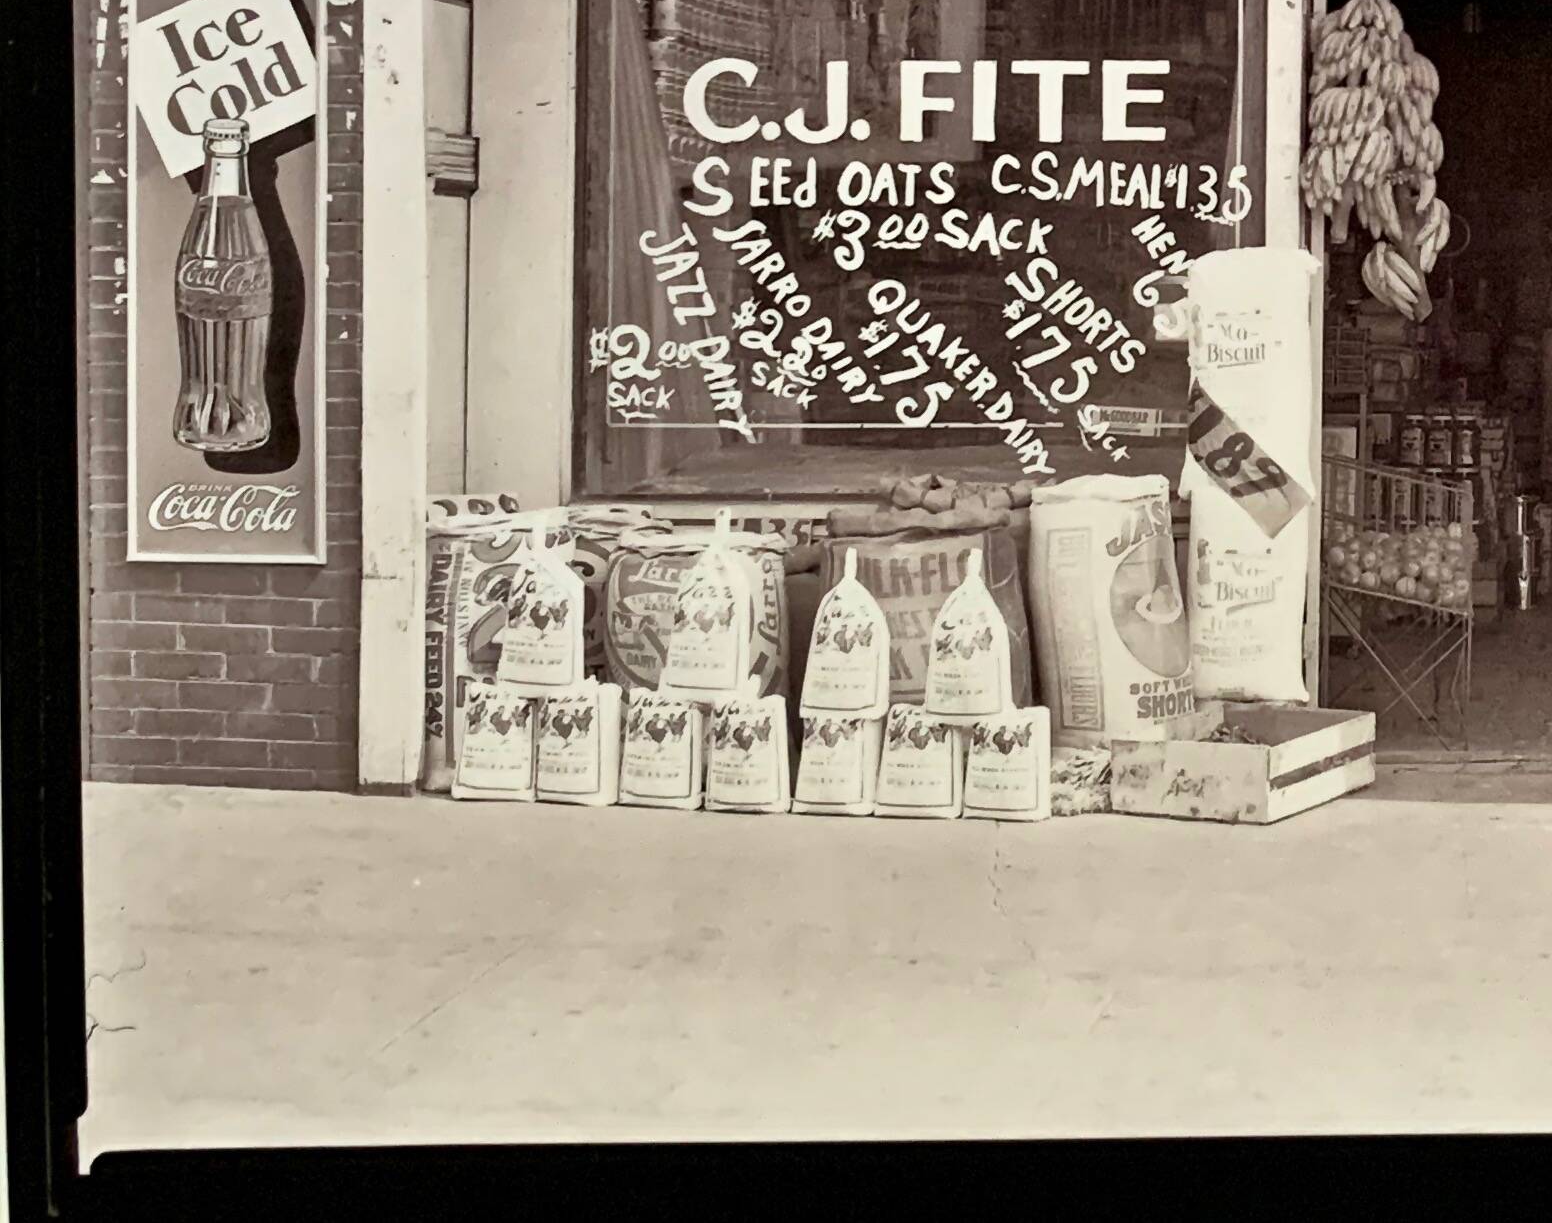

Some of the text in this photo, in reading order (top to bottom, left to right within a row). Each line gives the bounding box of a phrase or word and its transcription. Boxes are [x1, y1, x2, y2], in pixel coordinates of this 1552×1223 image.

[156, 7, 264, 79] Ice
[167, 40, 308, 137] Cold
[899, 59, 1170, 143] FITE
[837, 161, 956, 207] OATS
[934, 208, 1054, 256] SACK
[1131, 214, 1194, 275] HEN
[639, 222, 757, 444] JAZZ DAIRY
[1005, 257, 1146, 374] SHORTS
[751, 360, 818, 410] SACK
[801, 316, 885, 404] DAIRY
[606, 381, 675, 411] SACK
[984, 390, 1057, 475] DAIRY
[1076, 403, 1131, 463] SACK
[148, 483, 300, 532] Coca-Cola
[188, 484, 233, 492] DRINK
[426, 553, 453, 626] DAIRY
[425, 630, 444, 689] FEED
[1129, 679, 1170, 696] SOFT
